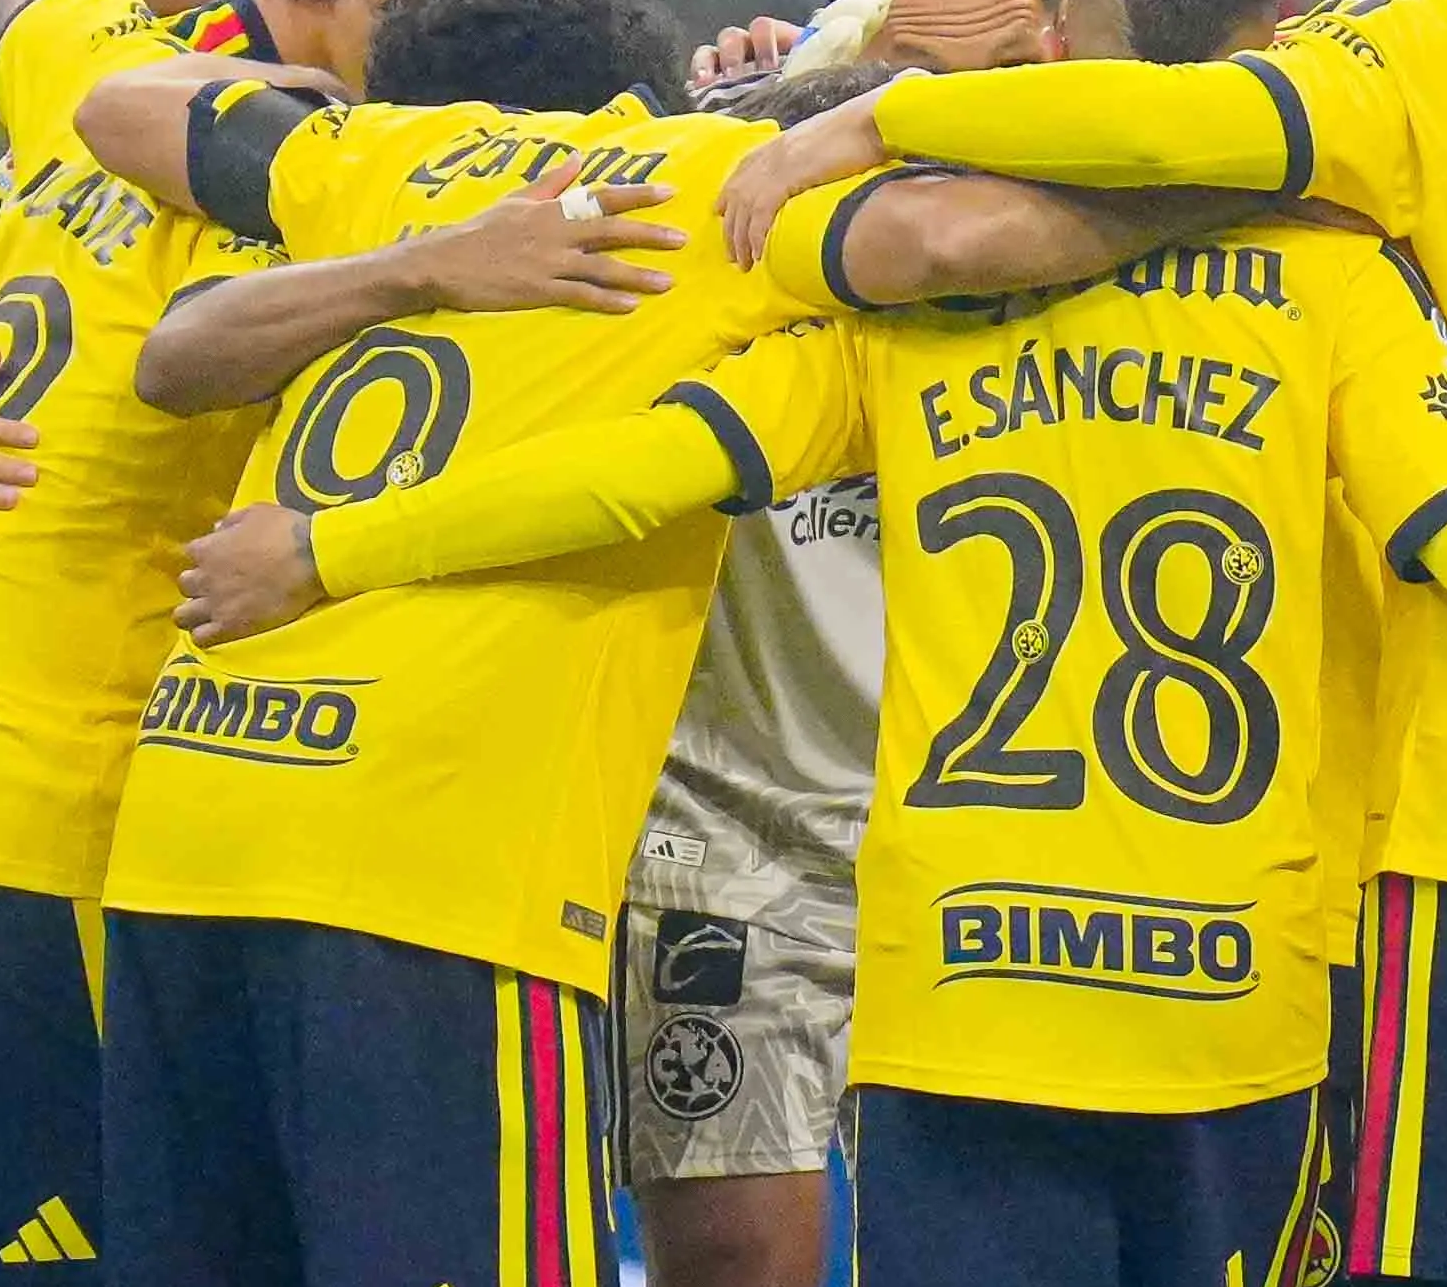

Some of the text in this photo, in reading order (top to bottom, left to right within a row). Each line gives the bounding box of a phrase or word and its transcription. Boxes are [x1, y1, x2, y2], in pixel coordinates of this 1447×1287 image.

[919, 338, 1282, 460] E.SÁNCHEZ
[903, 471, 1281, 826] 28
[141, 675, 358, 752] BIMBO
[941, 904, 1254, 983] BIMBO
